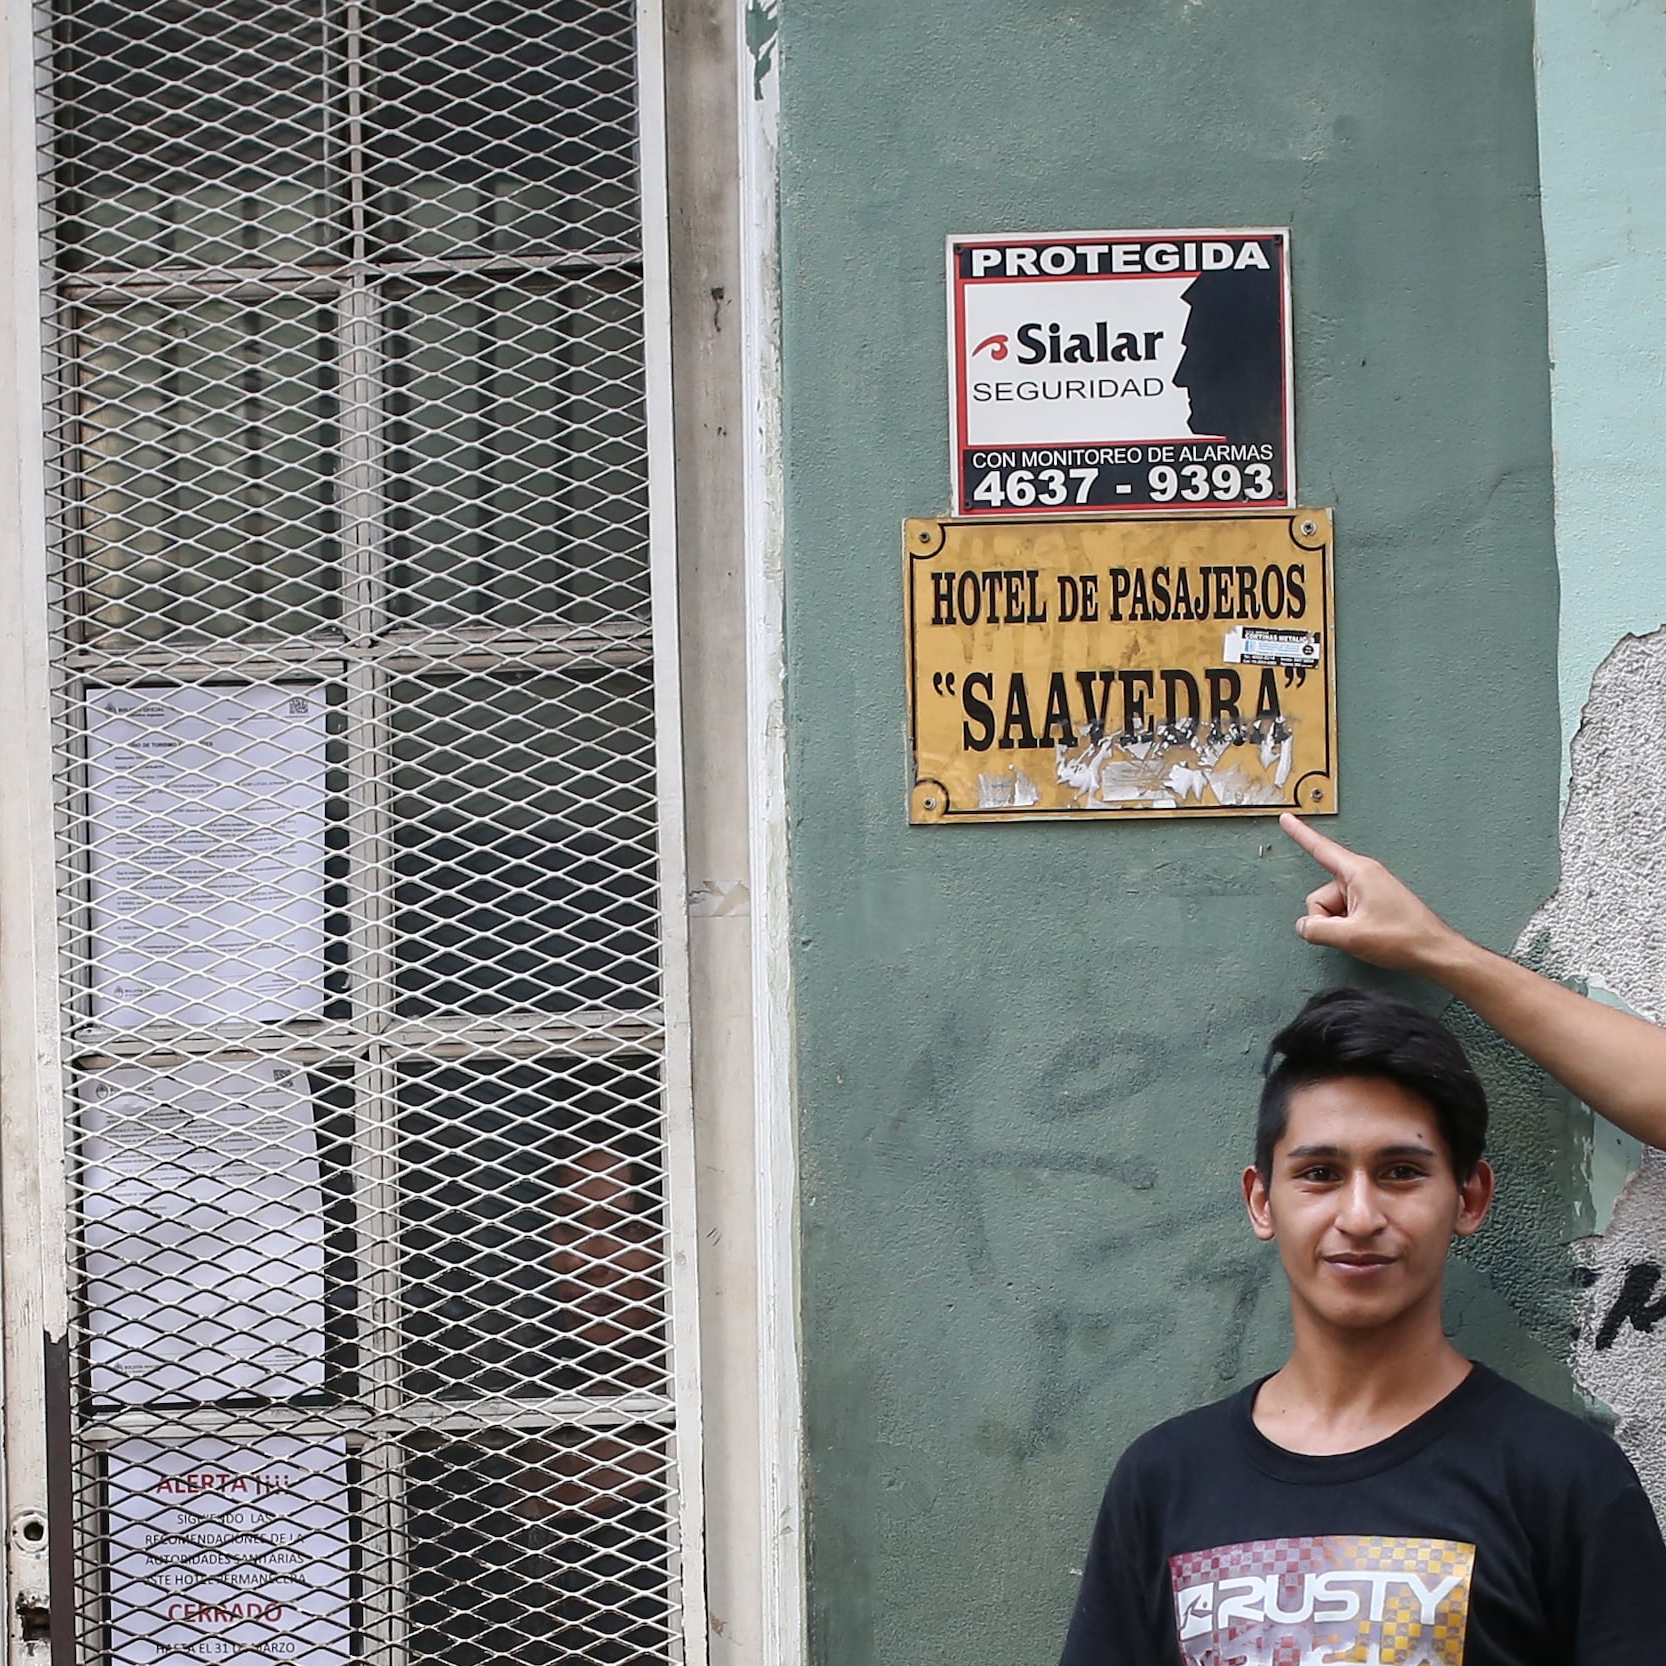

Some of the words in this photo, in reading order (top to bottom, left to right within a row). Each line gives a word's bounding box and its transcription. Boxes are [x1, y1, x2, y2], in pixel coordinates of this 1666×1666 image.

[971, 242, 1271, 277] PROTEGIDA
[1017, 321, 1165, 364] Sialar
[973, 378, 1165, 402] SEGURIDAD
[972, 452, 1019, 469] CON
[1021, 447, 1143, 467] MONITOREO
[1147, 446, 1176, 463] DE
[1179, 444, 1273, 462] ALARMAS
[973, 468, 1100, 507] 4637
[1148, 463, 1275, 503] 9393
[931, 569, 1047, 625] HOTEL
[1057, 574, 1099, 623] DE
[1109, 563, 1307, 622] PASAJEROS
[156, 1474, 246, 1494] ALERTA
[177, 1513, 244, 1524] SIGEDO
[271, 1533, 286, 1543] DE
[144, 1574, 171, 1585] STE
[168, 1601, 282, 1623] CERRADO
[1218, 1571, 1462, 1629] RUSTY
[199, 1643, 211, 1654] EL
[215, 1643, 228, 1654] 31
